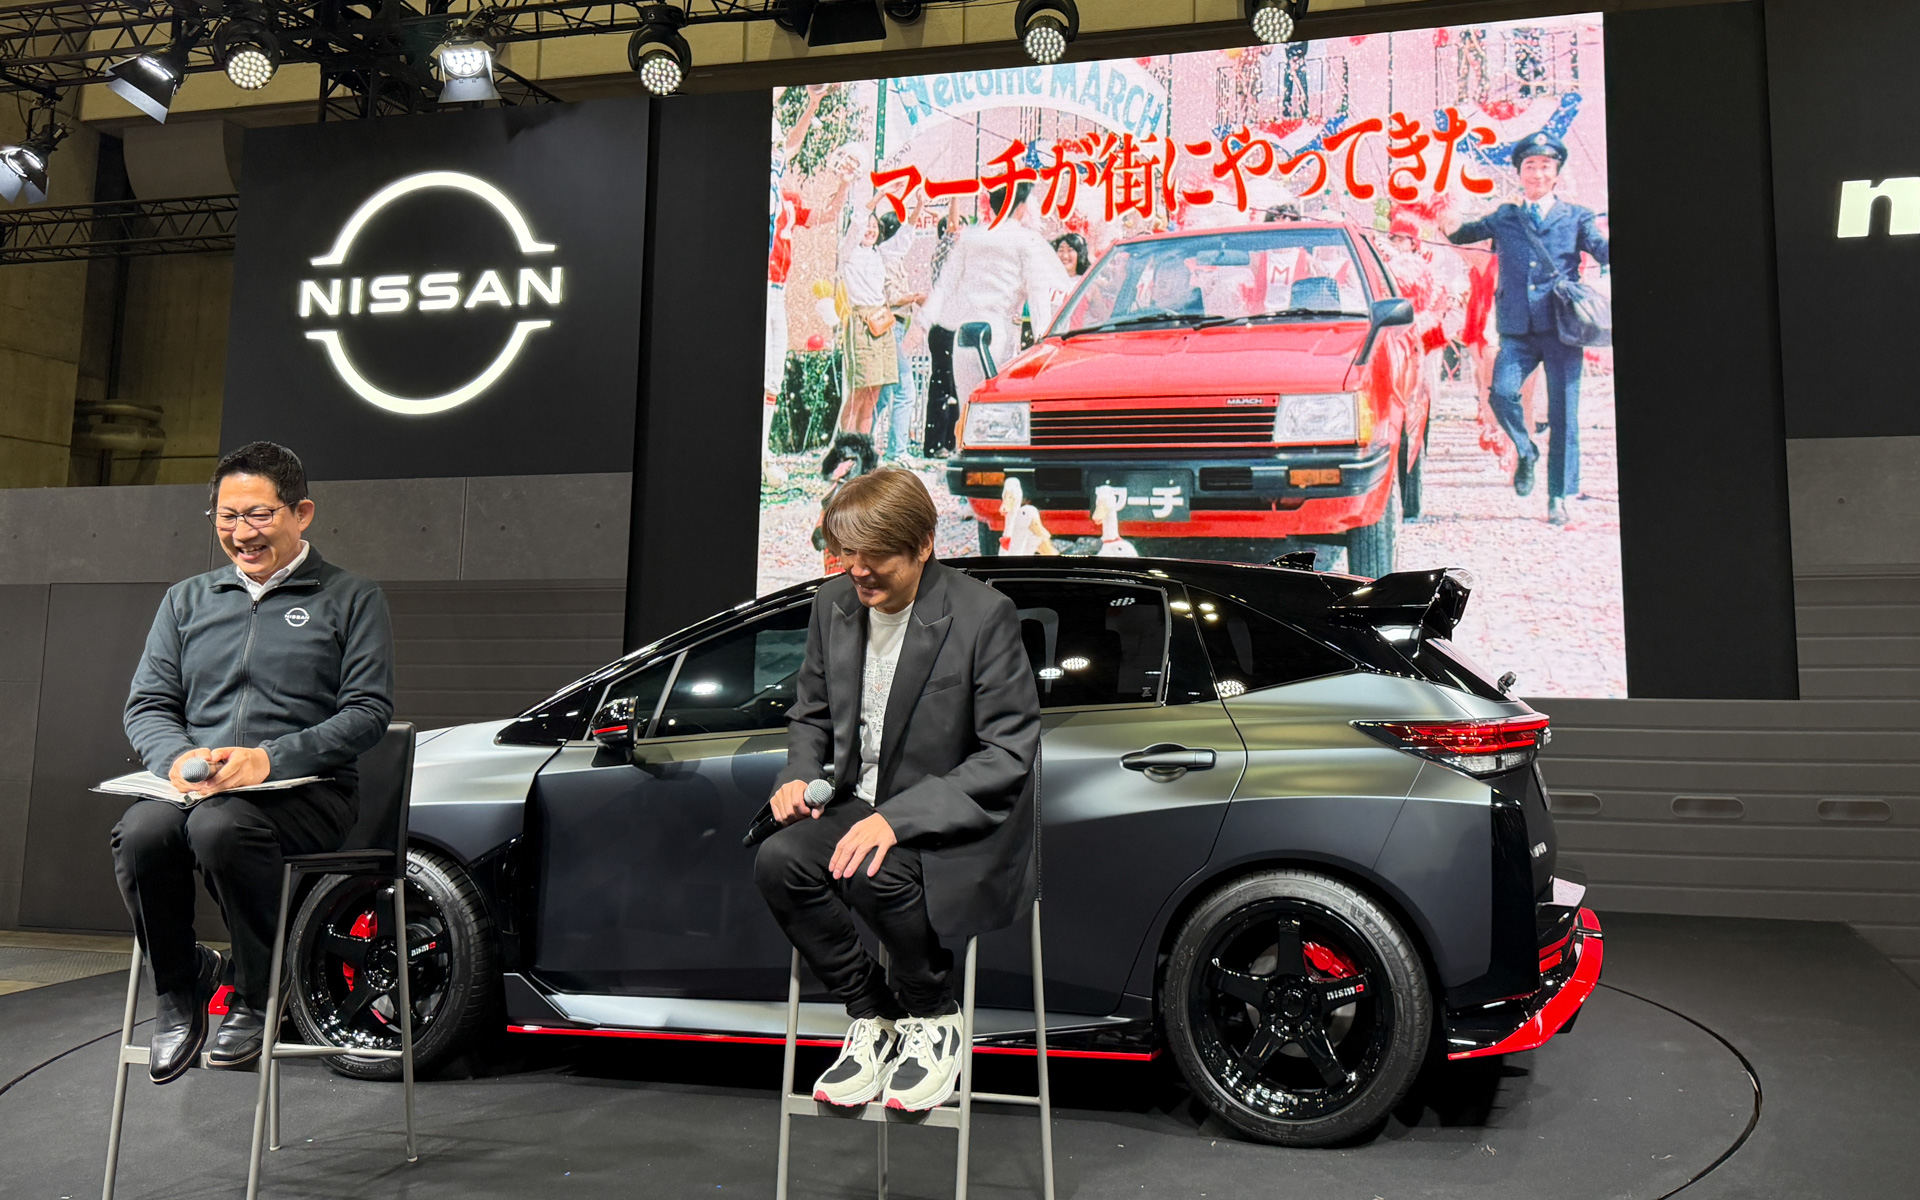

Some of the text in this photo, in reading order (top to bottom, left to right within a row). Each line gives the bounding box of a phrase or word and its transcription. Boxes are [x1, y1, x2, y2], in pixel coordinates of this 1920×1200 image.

[894, 62, 1164, 138] Welcome MARCH
[870, 108, 1497, 230] マーチが街にやってきた
[300, 267, 562, 317] NISSAN
